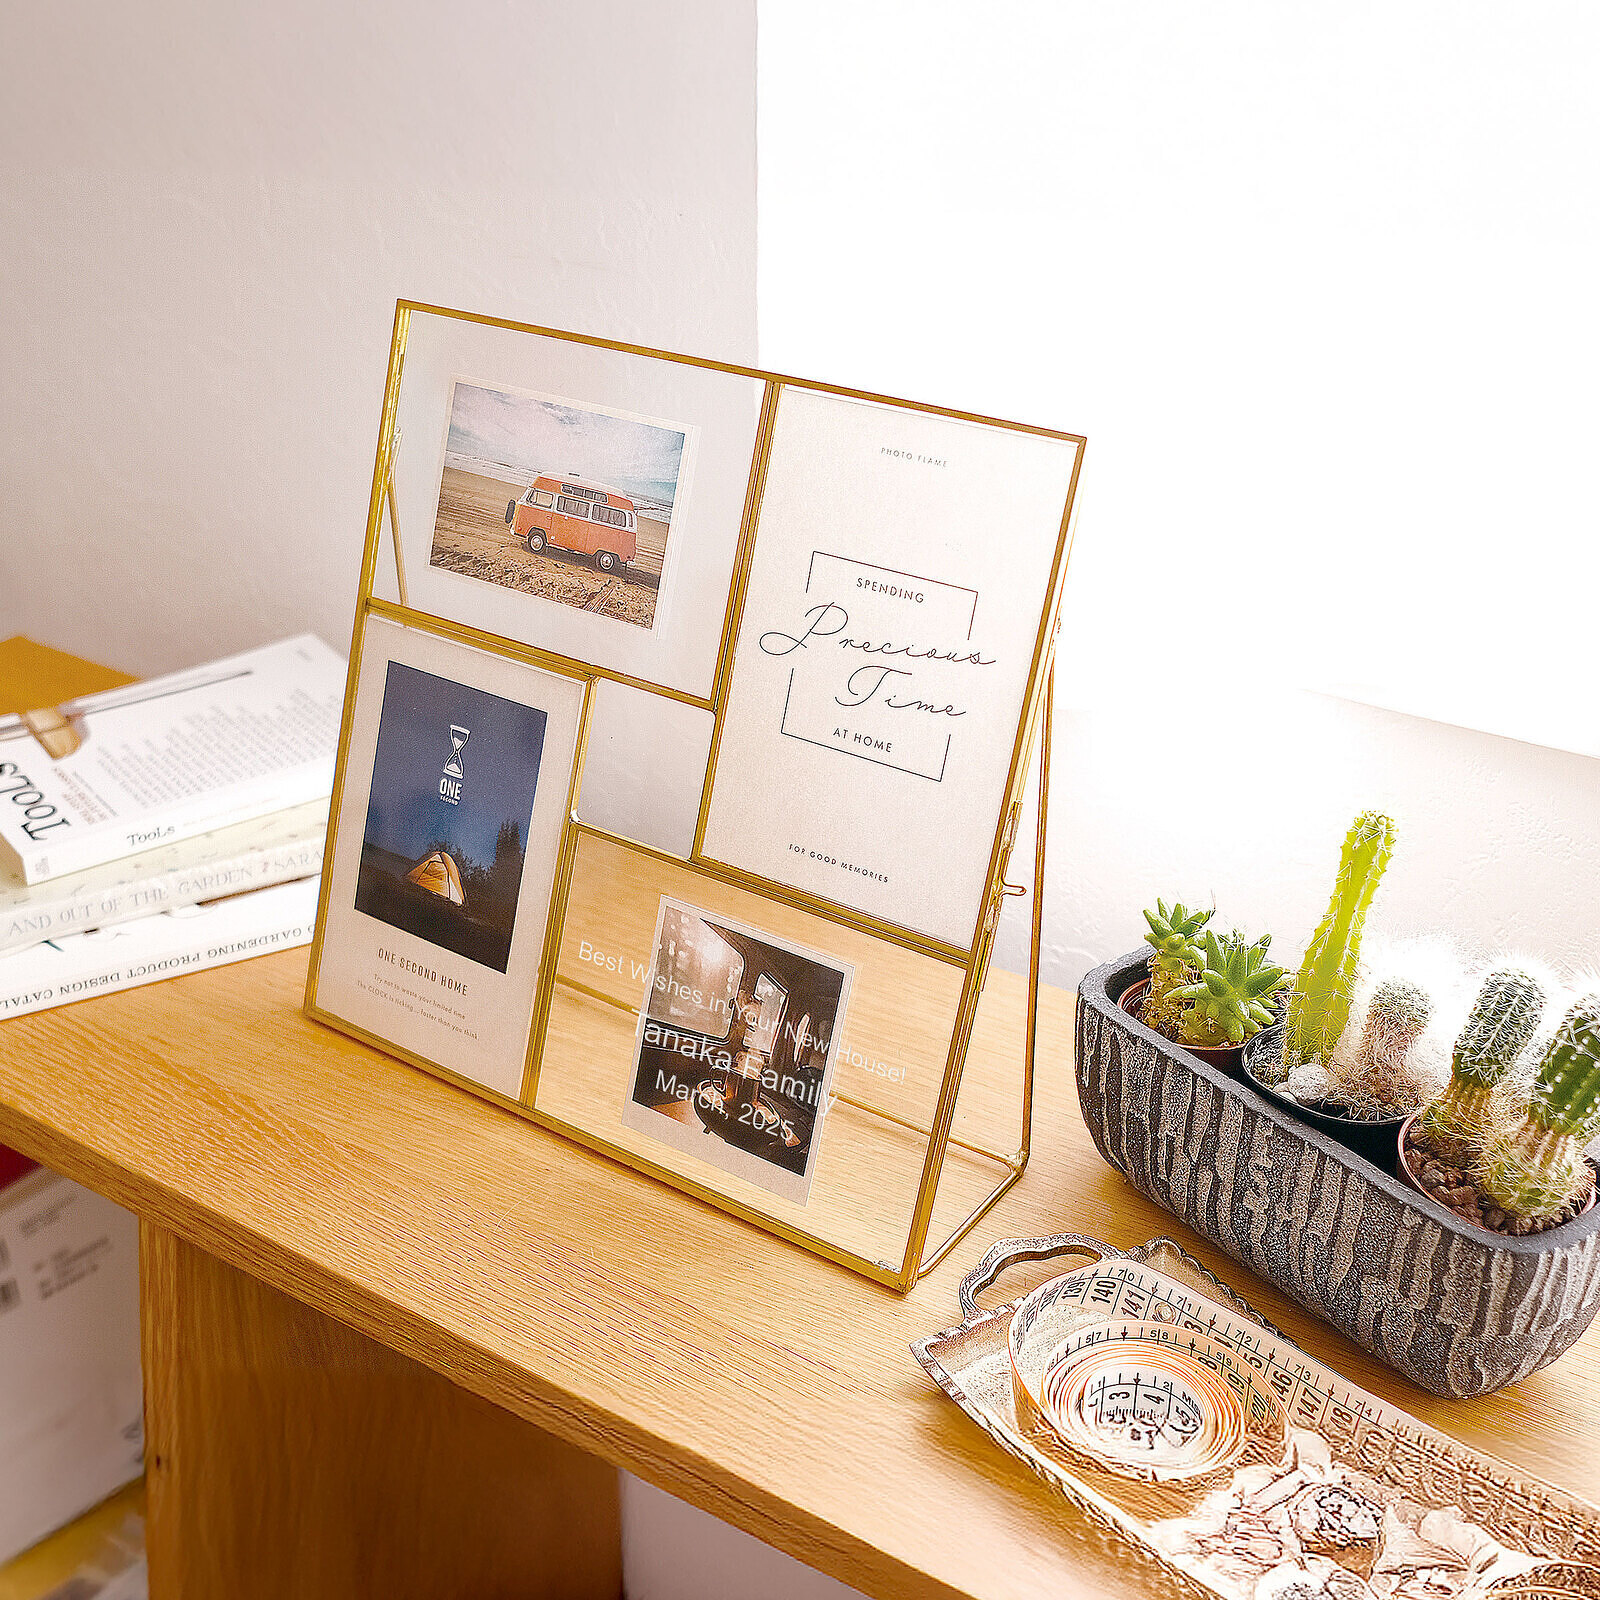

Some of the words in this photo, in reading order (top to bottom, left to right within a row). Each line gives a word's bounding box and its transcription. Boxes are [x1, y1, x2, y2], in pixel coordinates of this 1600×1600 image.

[881, 447, 912, 460] PHOTO
[856, 577, 925, 603] SPENDING
[759, 602, 996, 665] Precious
[834, 665, 966, 716] Time
[833, 728, 848, 739] AT
[854, 732, 893, 753] HOME
[440, 778, 463, 800] ONE
[788, 843, 806, 855] FOR
[809, 851, 837, 866] GOOD
[840, 862, 889, 883] MEMORIES
[9, 916, 51, 937] AND
[60, 903, 93, 923] OUT
[101, 896, 121, 914] OF
[129, 886, 169, 907] THE
[178, 866, 253, 895] GARDEN
[207, 928, 302, 959] GARDENING
[127, 953, 201, 979] PRODUCT
[378, 947, 397, 965] ONE
[399, 957, 437, 982] SECOND
[440, 975, 468, 996] HOME
[60, 972, 121, 995] DESIGN
[1090, 1280, 1117, 1304] 140
[1121, 1289, 1146, 1319] 141
[1270, 1370, 1293, 1402] 146
[1297, 1388, 1322, 1420] 147
